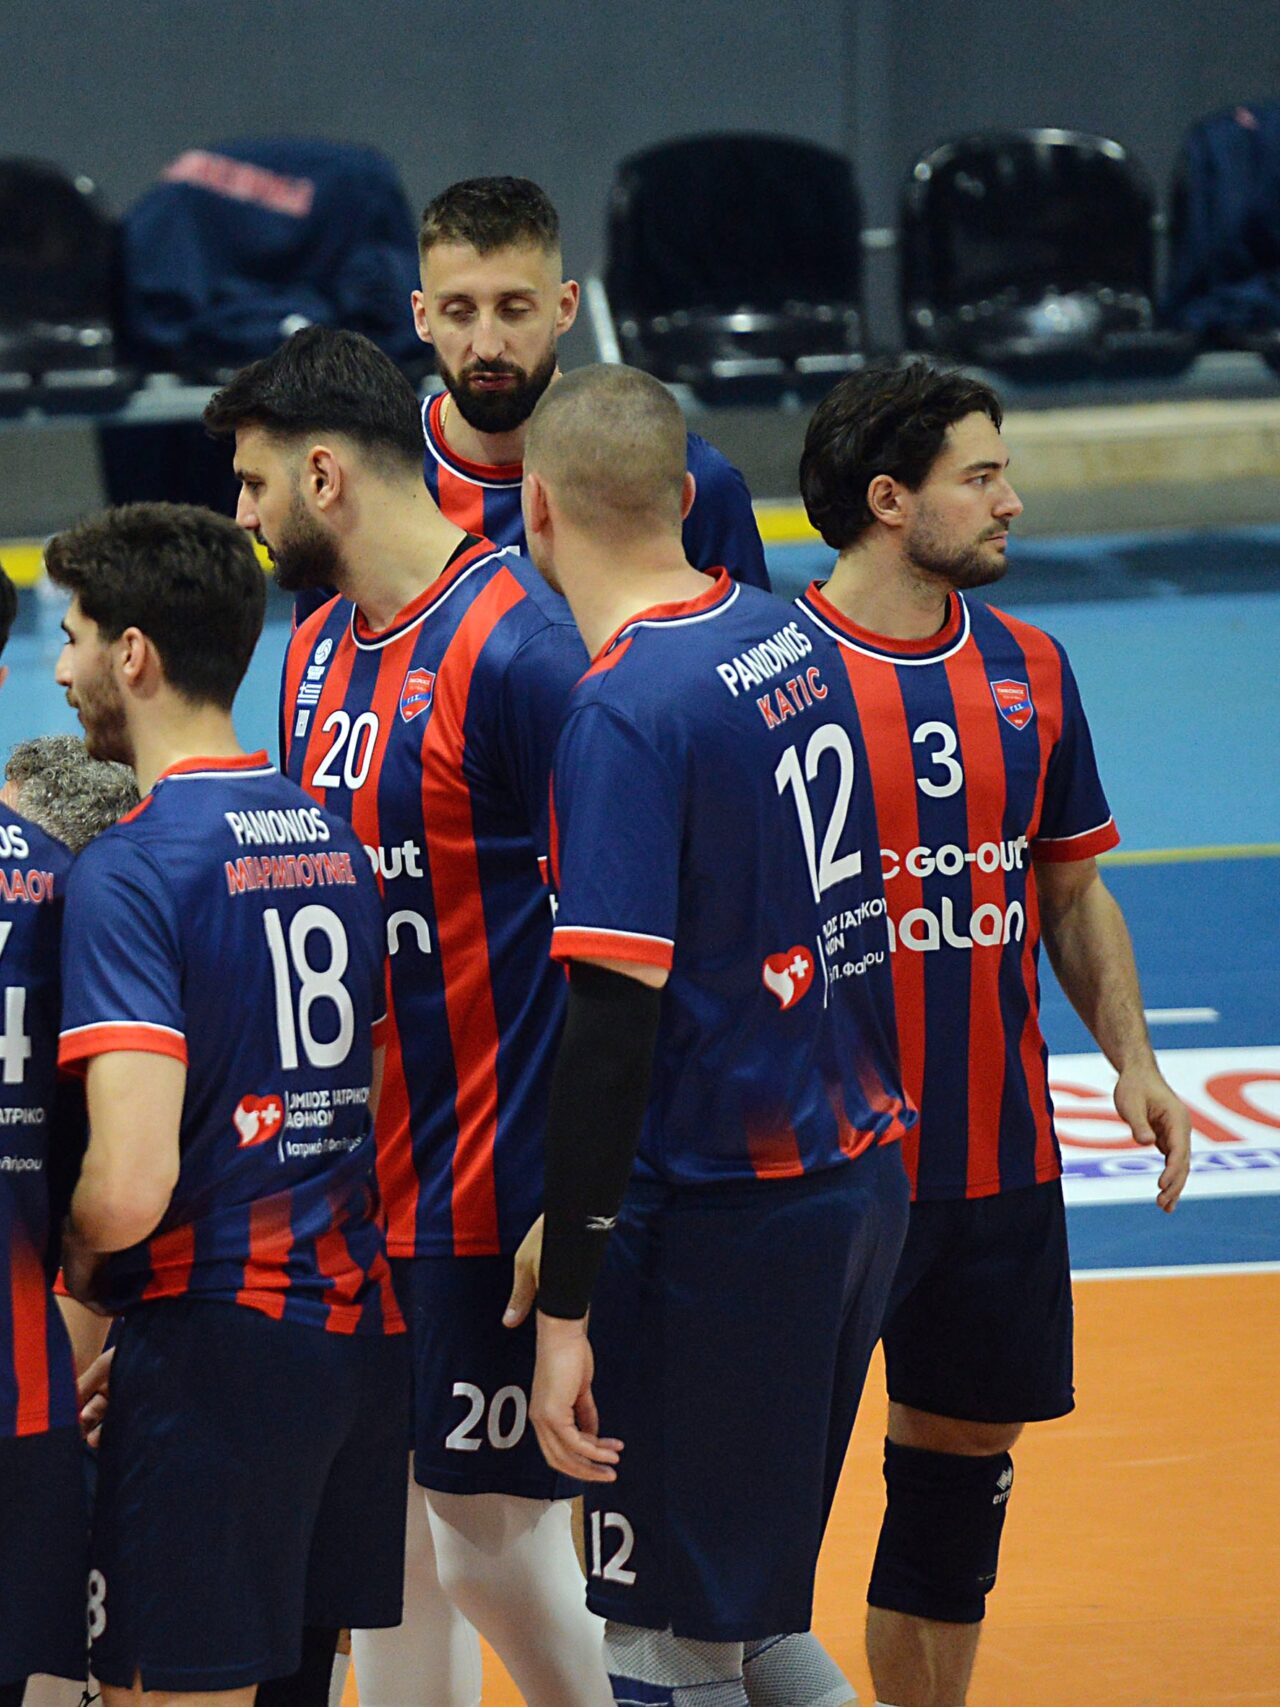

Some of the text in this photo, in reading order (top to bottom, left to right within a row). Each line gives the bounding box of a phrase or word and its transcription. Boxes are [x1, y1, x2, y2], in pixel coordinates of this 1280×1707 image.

[716, 621, 813, 697] PANIONIOS
[756, 666, 829, 729] KATIC
[311, 710, 379, 790] 20
[912, 721, 964, 798] 3
[225, 807, 330, 846] PANIONIOS
[774, 723, 862, 904] 12
[263, 904, 354, 1070] 18
[445, 1382, 528, 1451] 20
[591, 1510, 637, 1586] 12
